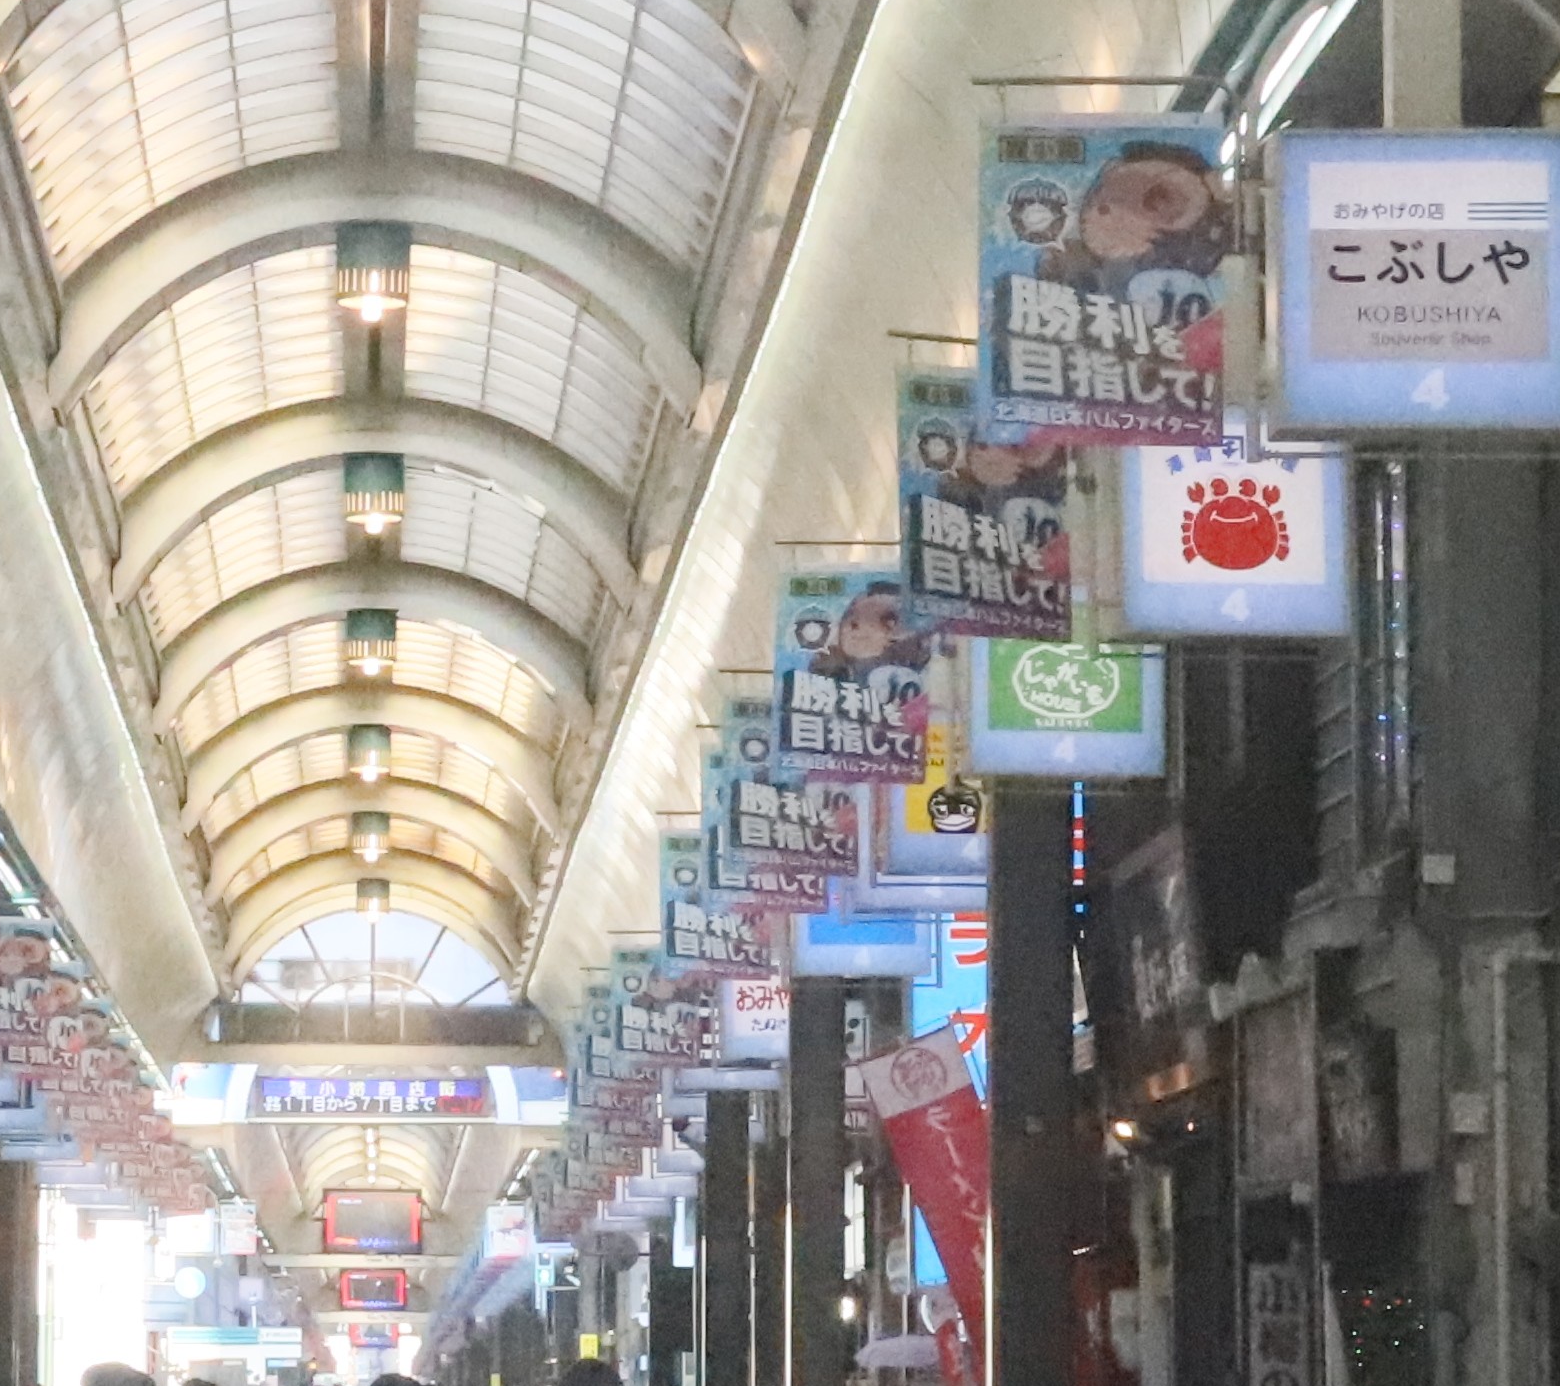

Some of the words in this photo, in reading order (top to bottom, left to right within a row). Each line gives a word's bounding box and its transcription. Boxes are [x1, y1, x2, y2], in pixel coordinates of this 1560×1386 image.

[1334, 202, 1445, 220] おみやげの店
[1328, 240, 1530, 284] こぶしや
[1008, 275, 1187, 361] 勝利を
[1358, 306, 1501, 324] KOBUSHIYA
[1008, 336, 1215, 411] 目指して!
[1410, 367, 1450, 410] 4
[1221, 589, 1250, 622] 4
[791, 671, 905, 727] 勝利を
[791, 723, 923, 760] 目指して!
[741, 818, 855, 858] 目指して!
